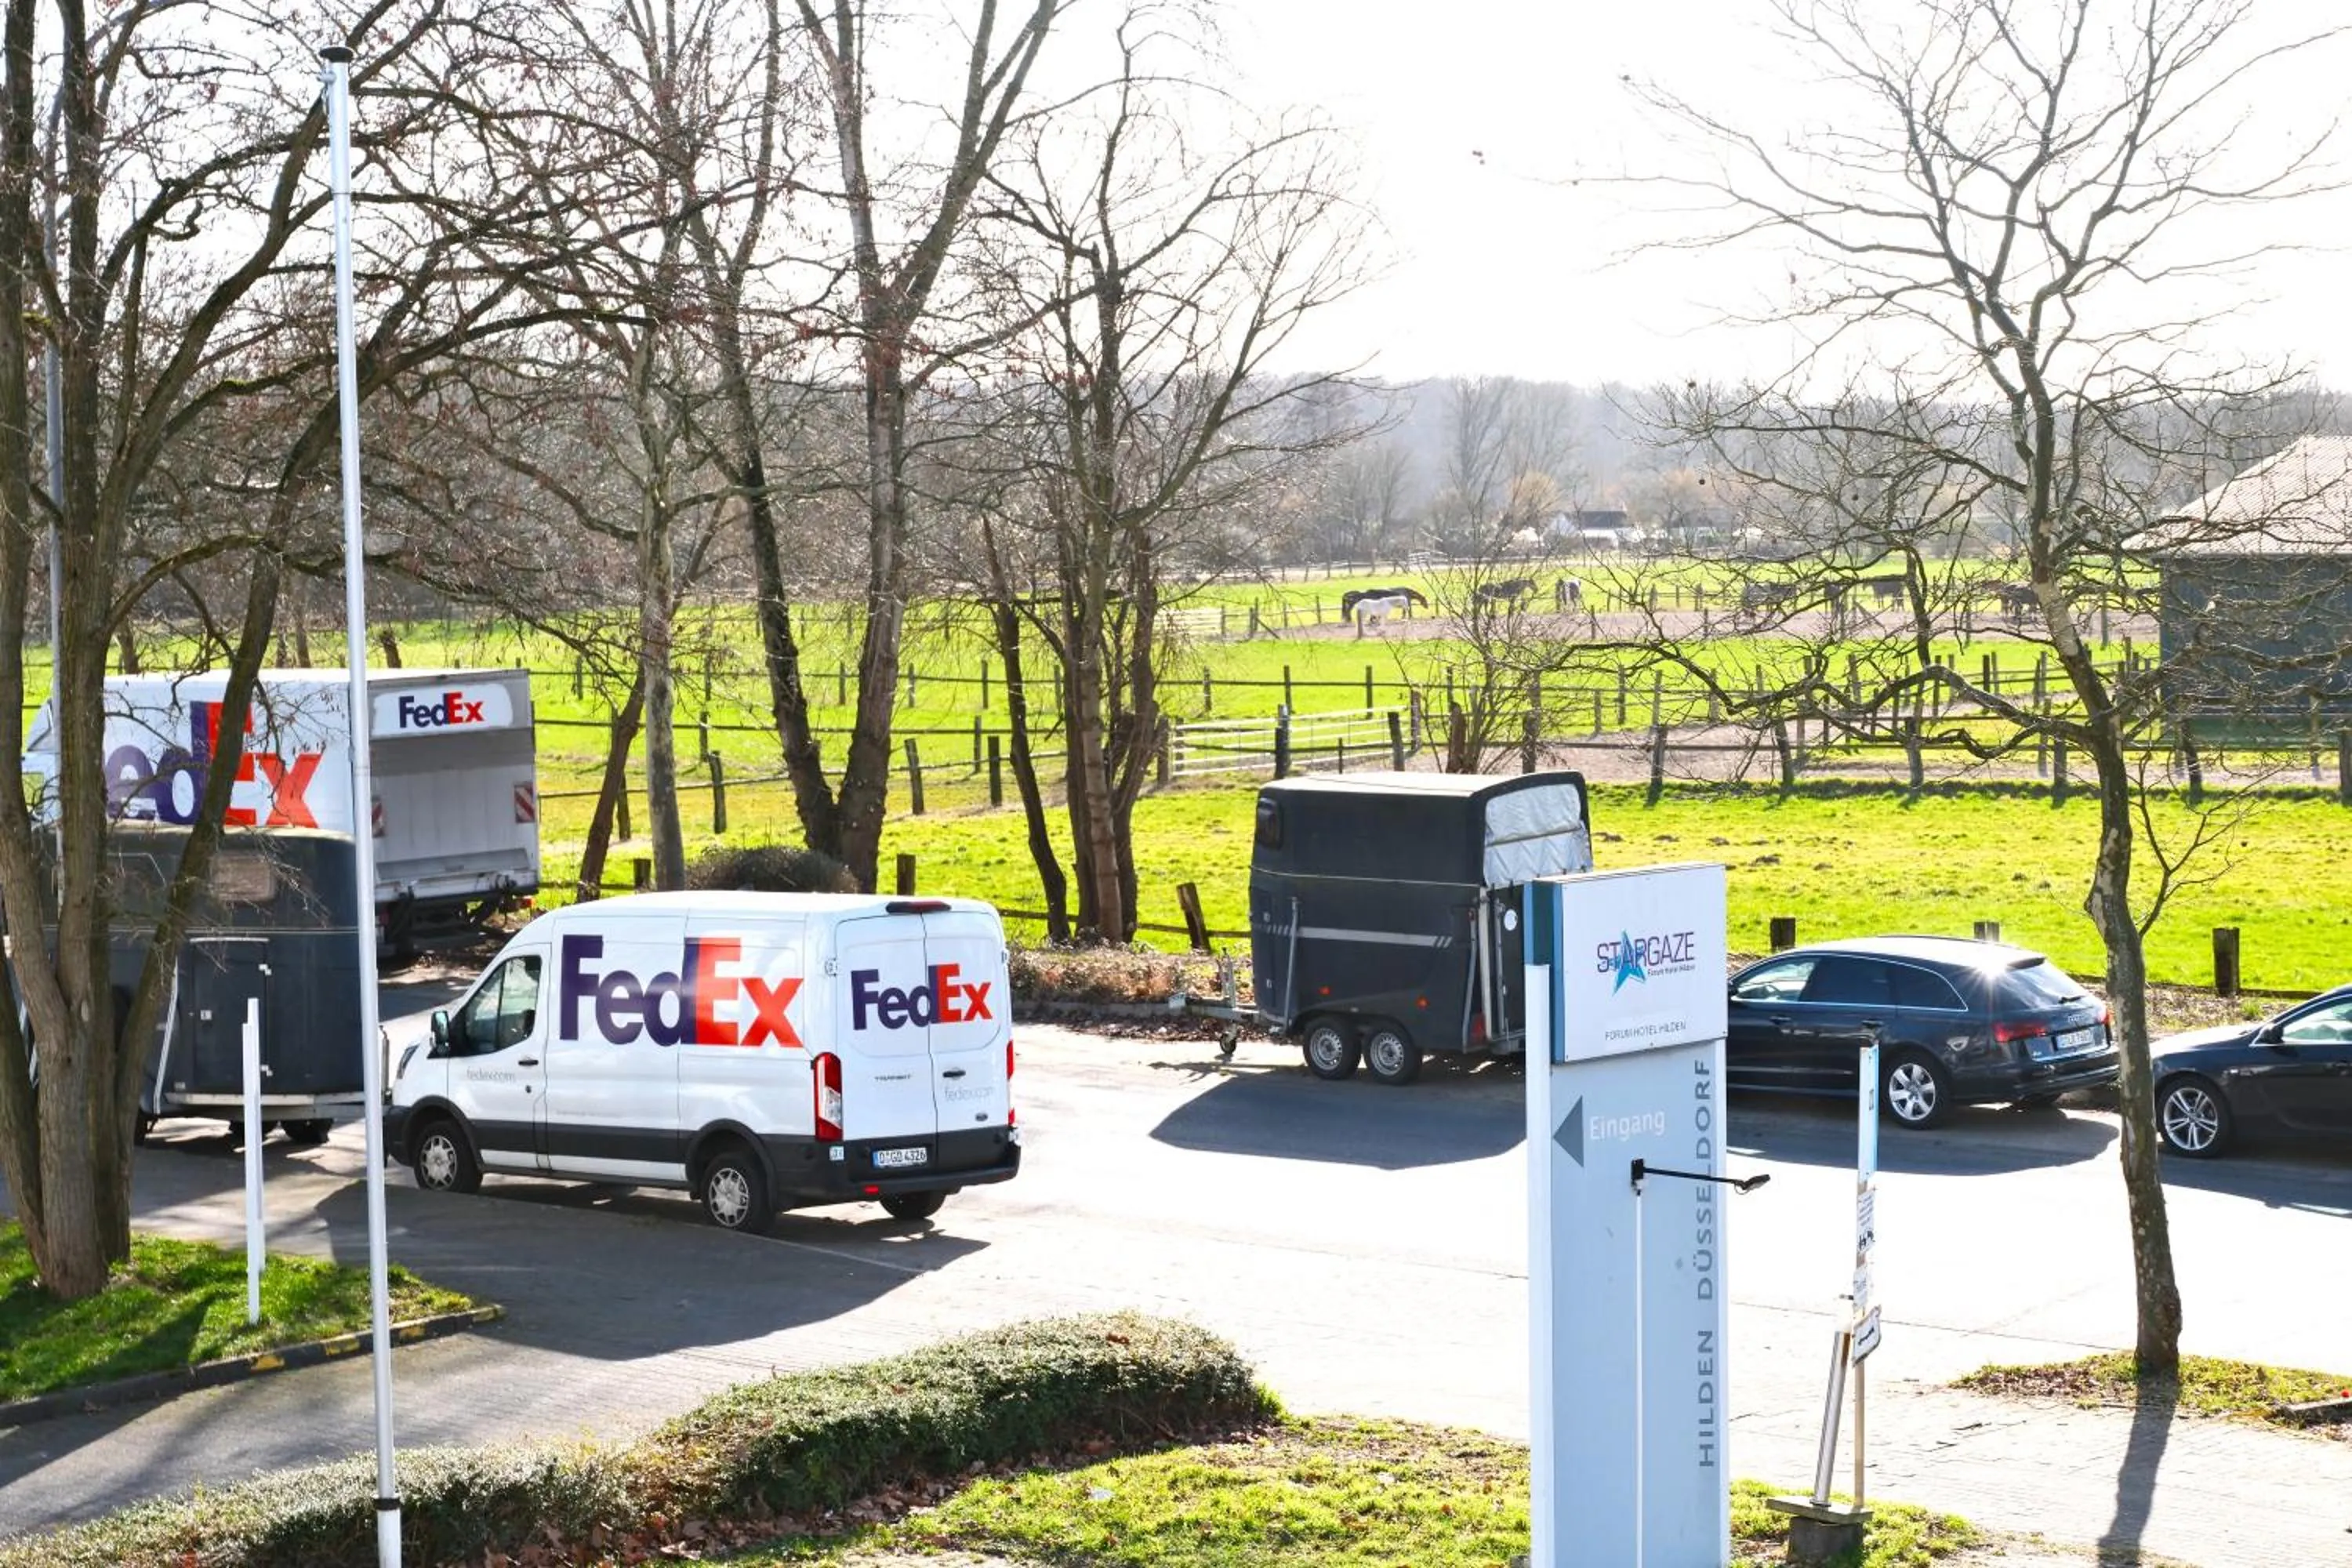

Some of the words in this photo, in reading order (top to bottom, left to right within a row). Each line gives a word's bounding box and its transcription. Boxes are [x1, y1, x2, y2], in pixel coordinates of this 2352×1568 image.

[399, 691, 484, 728] FedEx
[104, 700, 323, 828] edEx
[1597, 931, 1694, 973] STARGAZE
[560, 934, 804, 1047] FedEx
[851, 963, 993, 1030] FedEx
[1605, 1028, 1632, 1040] FORUM
[1634, 1025, 1658, 1037] HOTEL
[1590, 1109, 1666, 1141] Eingang
[1697, 1330, 1715, 1467] HILDEN
